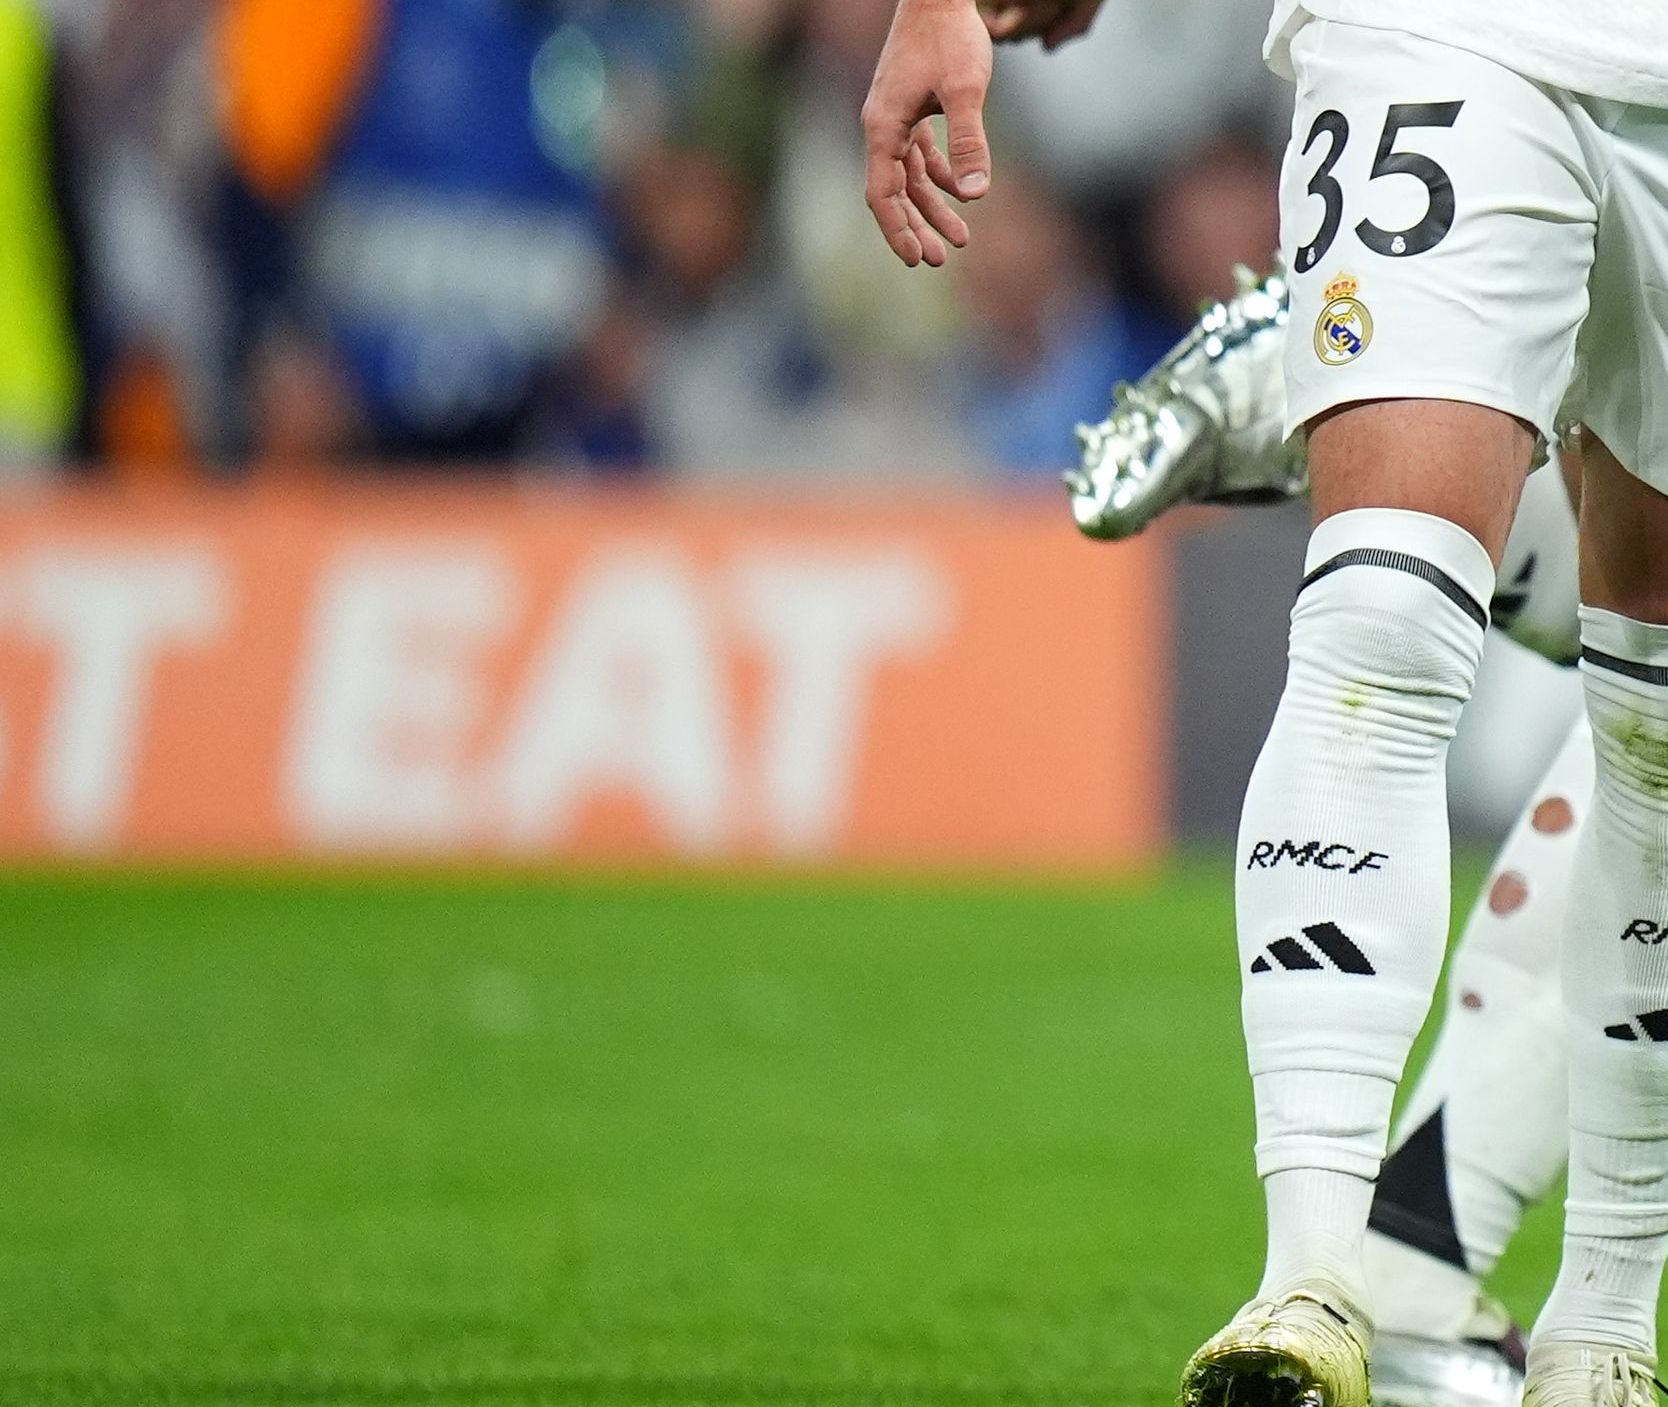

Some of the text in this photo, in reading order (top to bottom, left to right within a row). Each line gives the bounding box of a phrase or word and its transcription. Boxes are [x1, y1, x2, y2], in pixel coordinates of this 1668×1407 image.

[1294, 100, 1466, 274] 35
[0, 535, 950, 854] T EAT
[1247, 839, 1390, 874] RMCF
